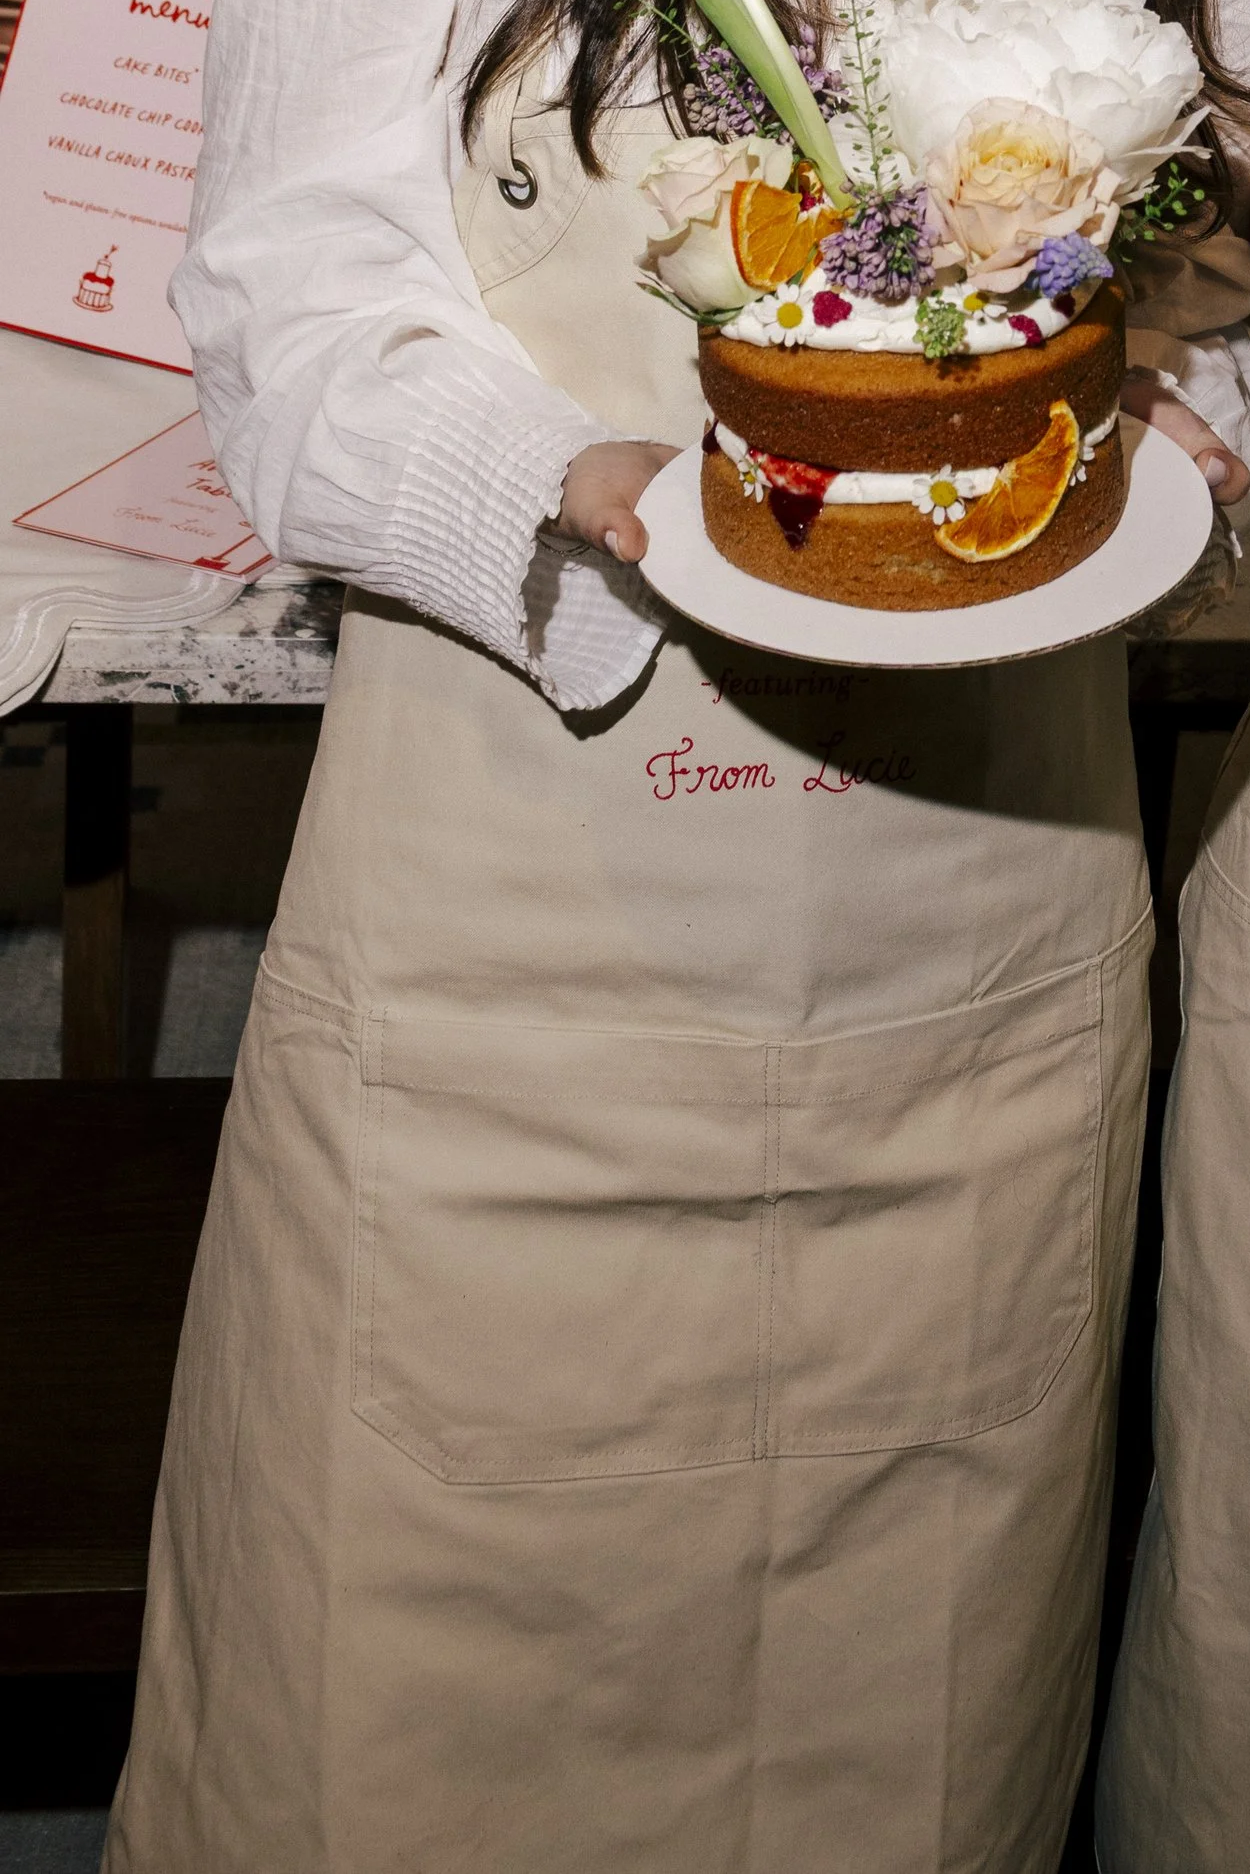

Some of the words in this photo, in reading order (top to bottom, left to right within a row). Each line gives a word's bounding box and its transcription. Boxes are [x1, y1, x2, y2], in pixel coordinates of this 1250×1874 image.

[113, 56, 151, 75] CAKE
[59, 92, 134, 119] CHOCOLATE
[137, 109, 173, 127] CHIP
[48, 135, 102, 159] VANILLA
[105, 150, 151, 172] CHOUX
[154, 160, 197, 182] PASTR
[186, 476, 233, 499] Tab
[645, 736, 776, 801] From
[802, 730, 920, 794] Lucie
